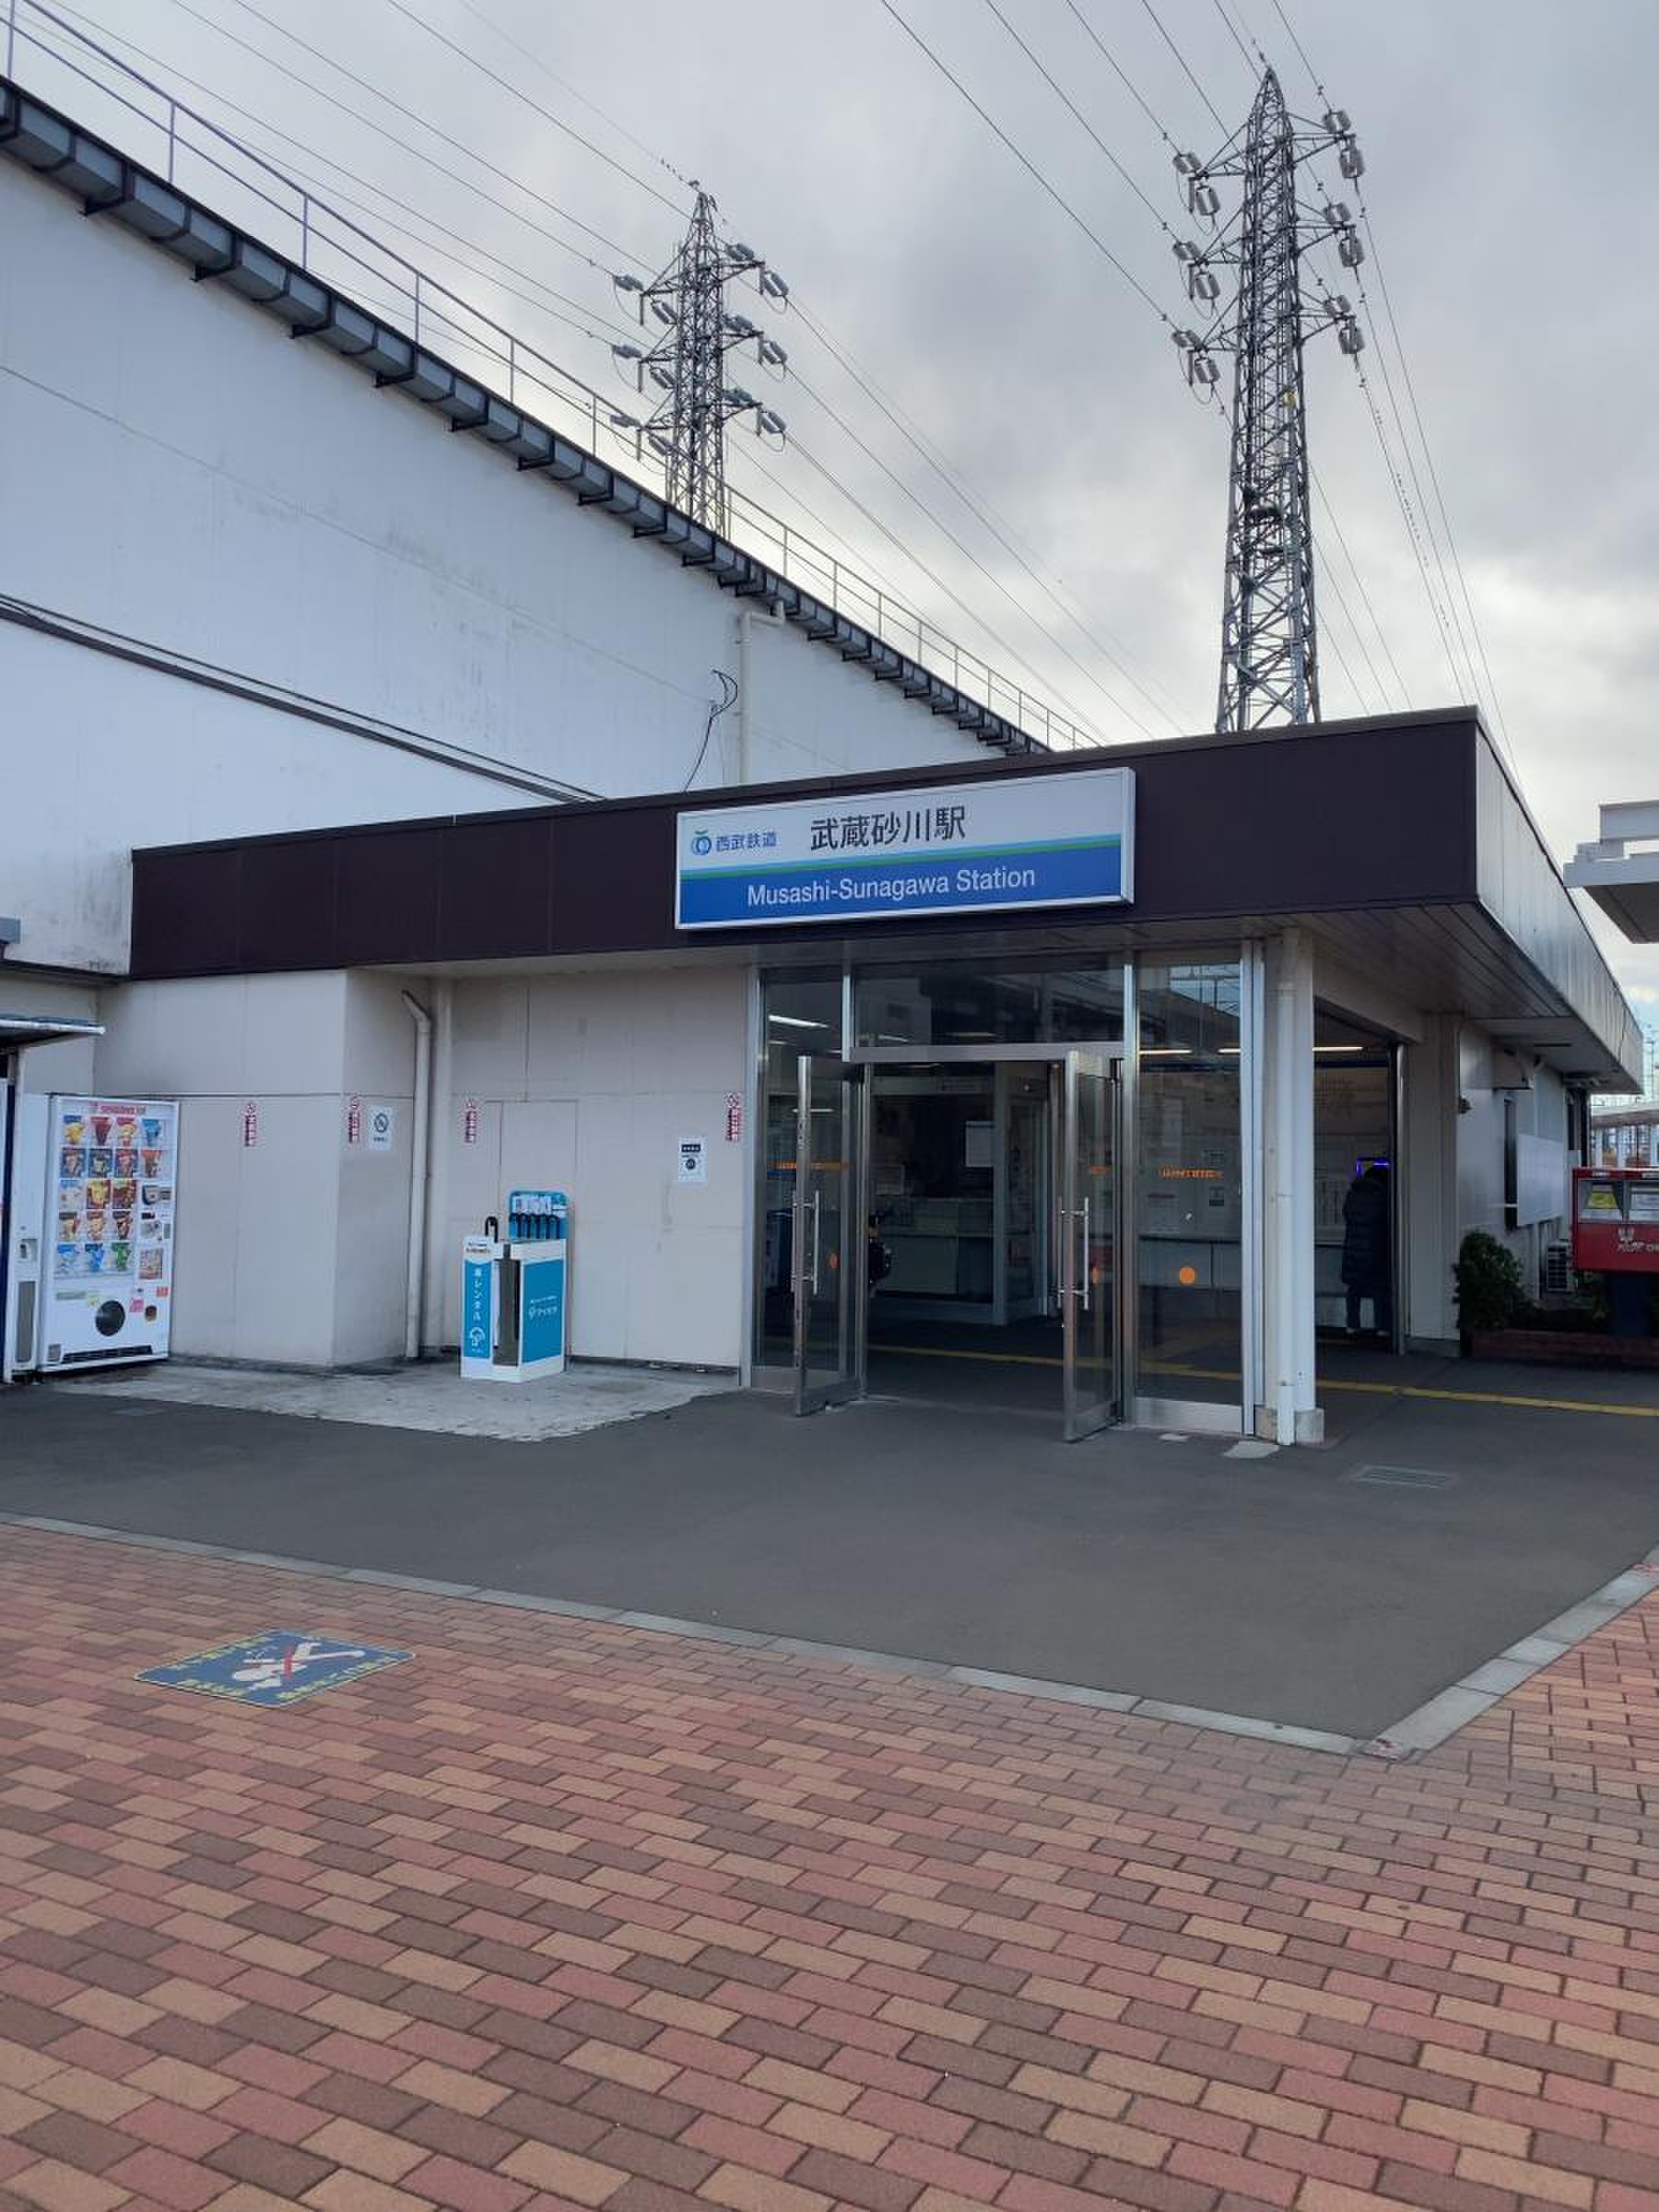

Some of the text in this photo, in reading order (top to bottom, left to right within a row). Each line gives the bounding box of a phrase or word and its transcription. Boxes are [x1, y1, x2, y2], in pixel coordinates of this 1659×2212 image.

[716, 831, 777, 852] 西武鉄道
[810, 806, 966, 851] 武蔵砂川駅
[747, 865, 1036, 906] Musashi-Sunagawa Station
